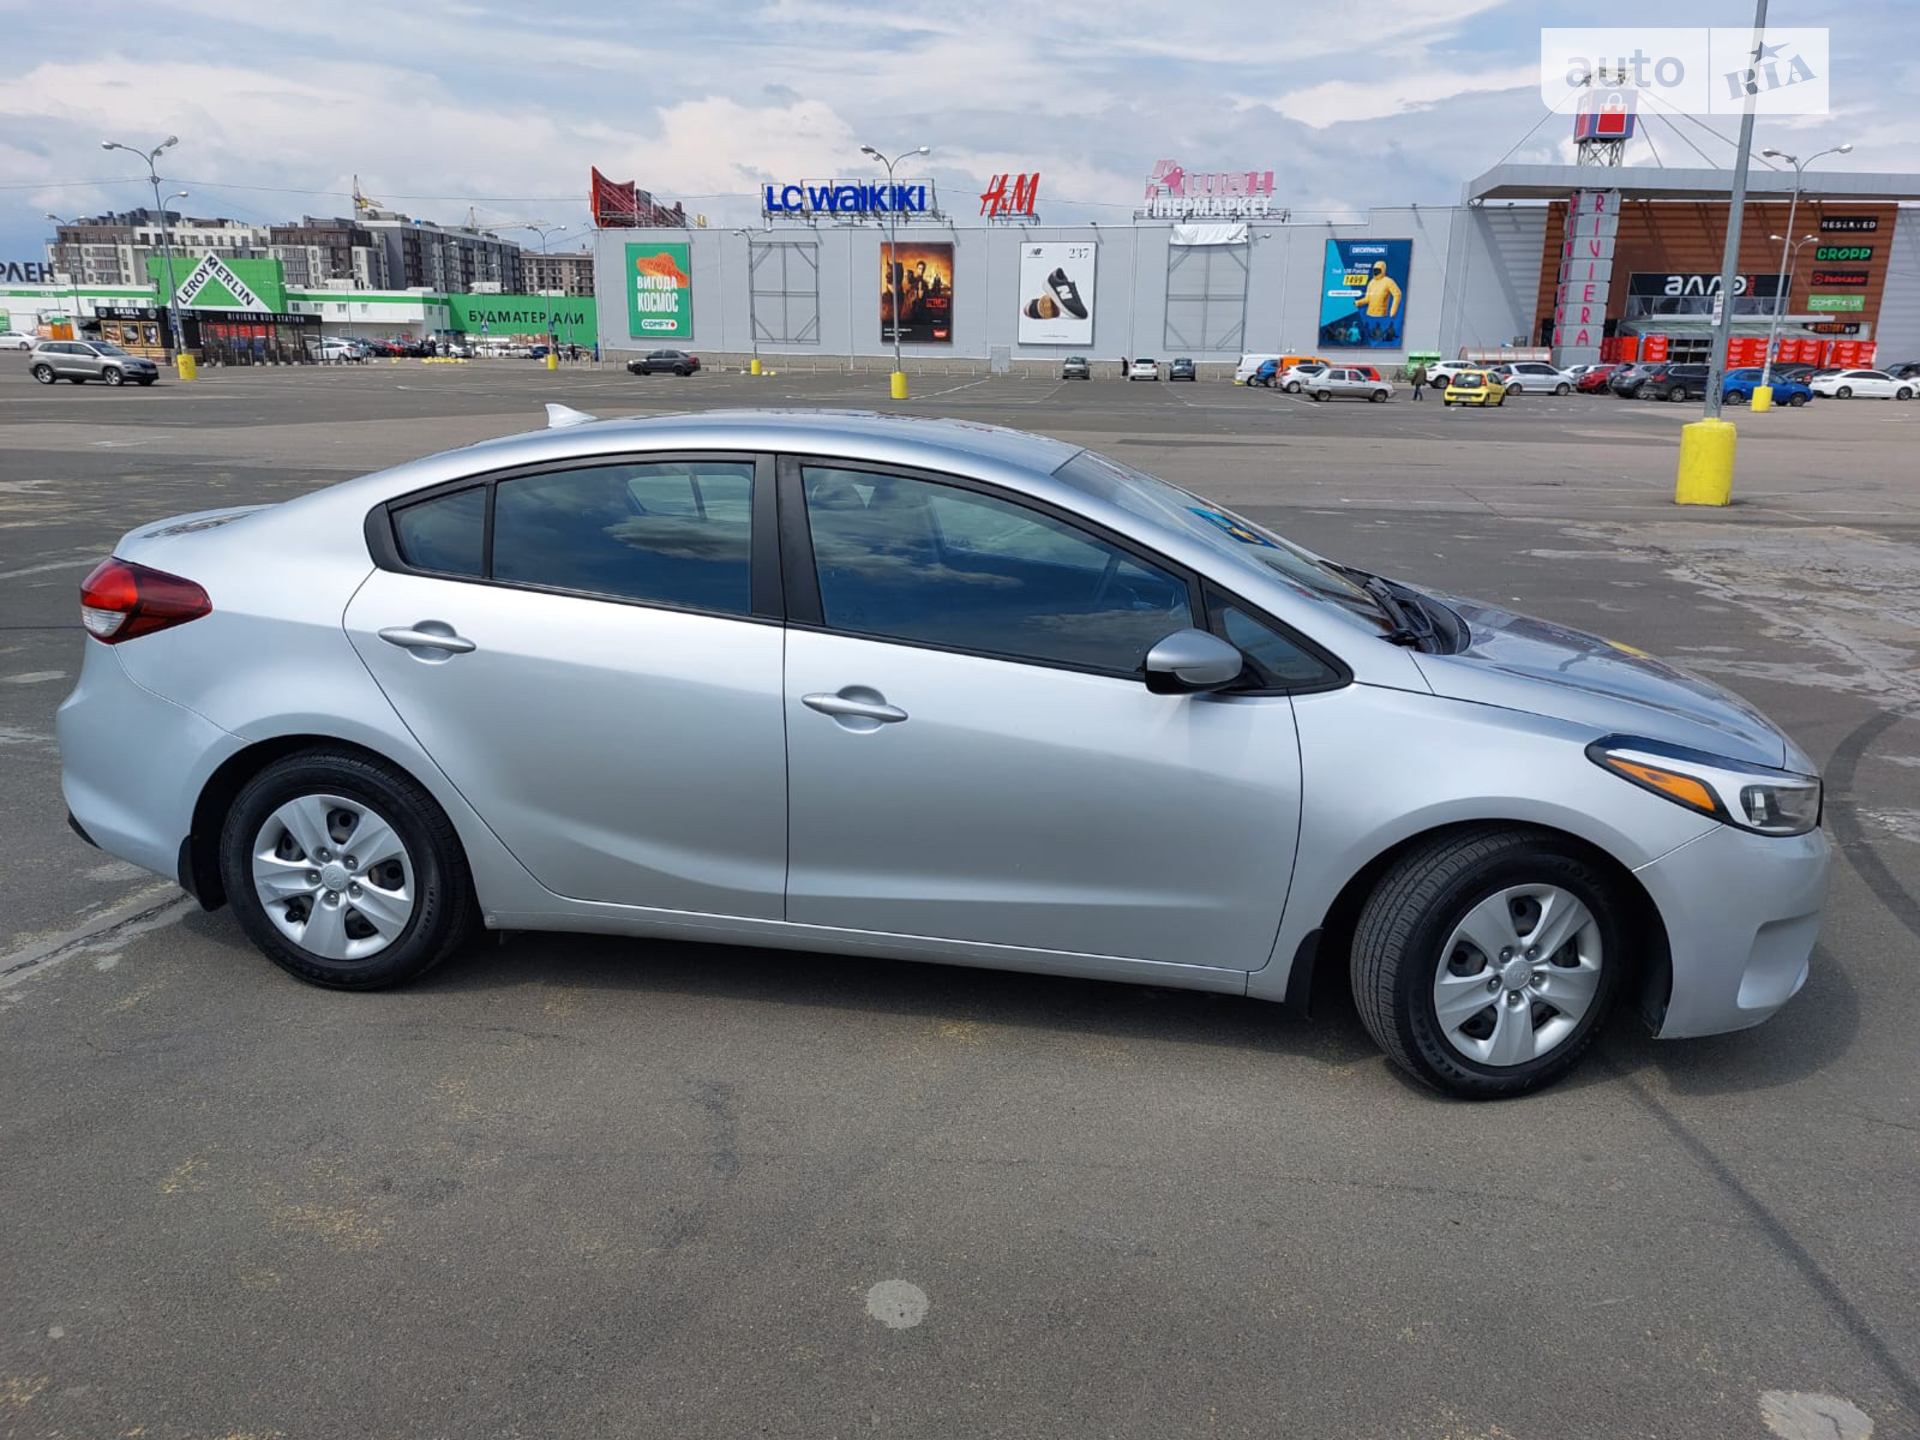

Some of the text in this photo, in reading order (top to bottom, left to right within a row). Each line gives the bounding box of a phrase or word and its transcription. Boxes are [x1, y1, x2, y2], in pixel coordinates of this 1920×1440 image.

[766, 186, 803, 212] LC
[979, 172, 1040, 216] H&M
[1822, 221, 1876, 229] RESERVED
[1816, 248, 1871, 260] CROPP
[1576, 194, 1605, 346] RIVIERA
[177, 256, 255, 306] LEROY MERLIN
[636, 275, 678, 292] ВИГОДА
[637, 292, 679, 312] КОСМОС
[114, 307, 140, 316] SKULL
[468, 310, 584, 325] БУДМАТЕРАЛИ
